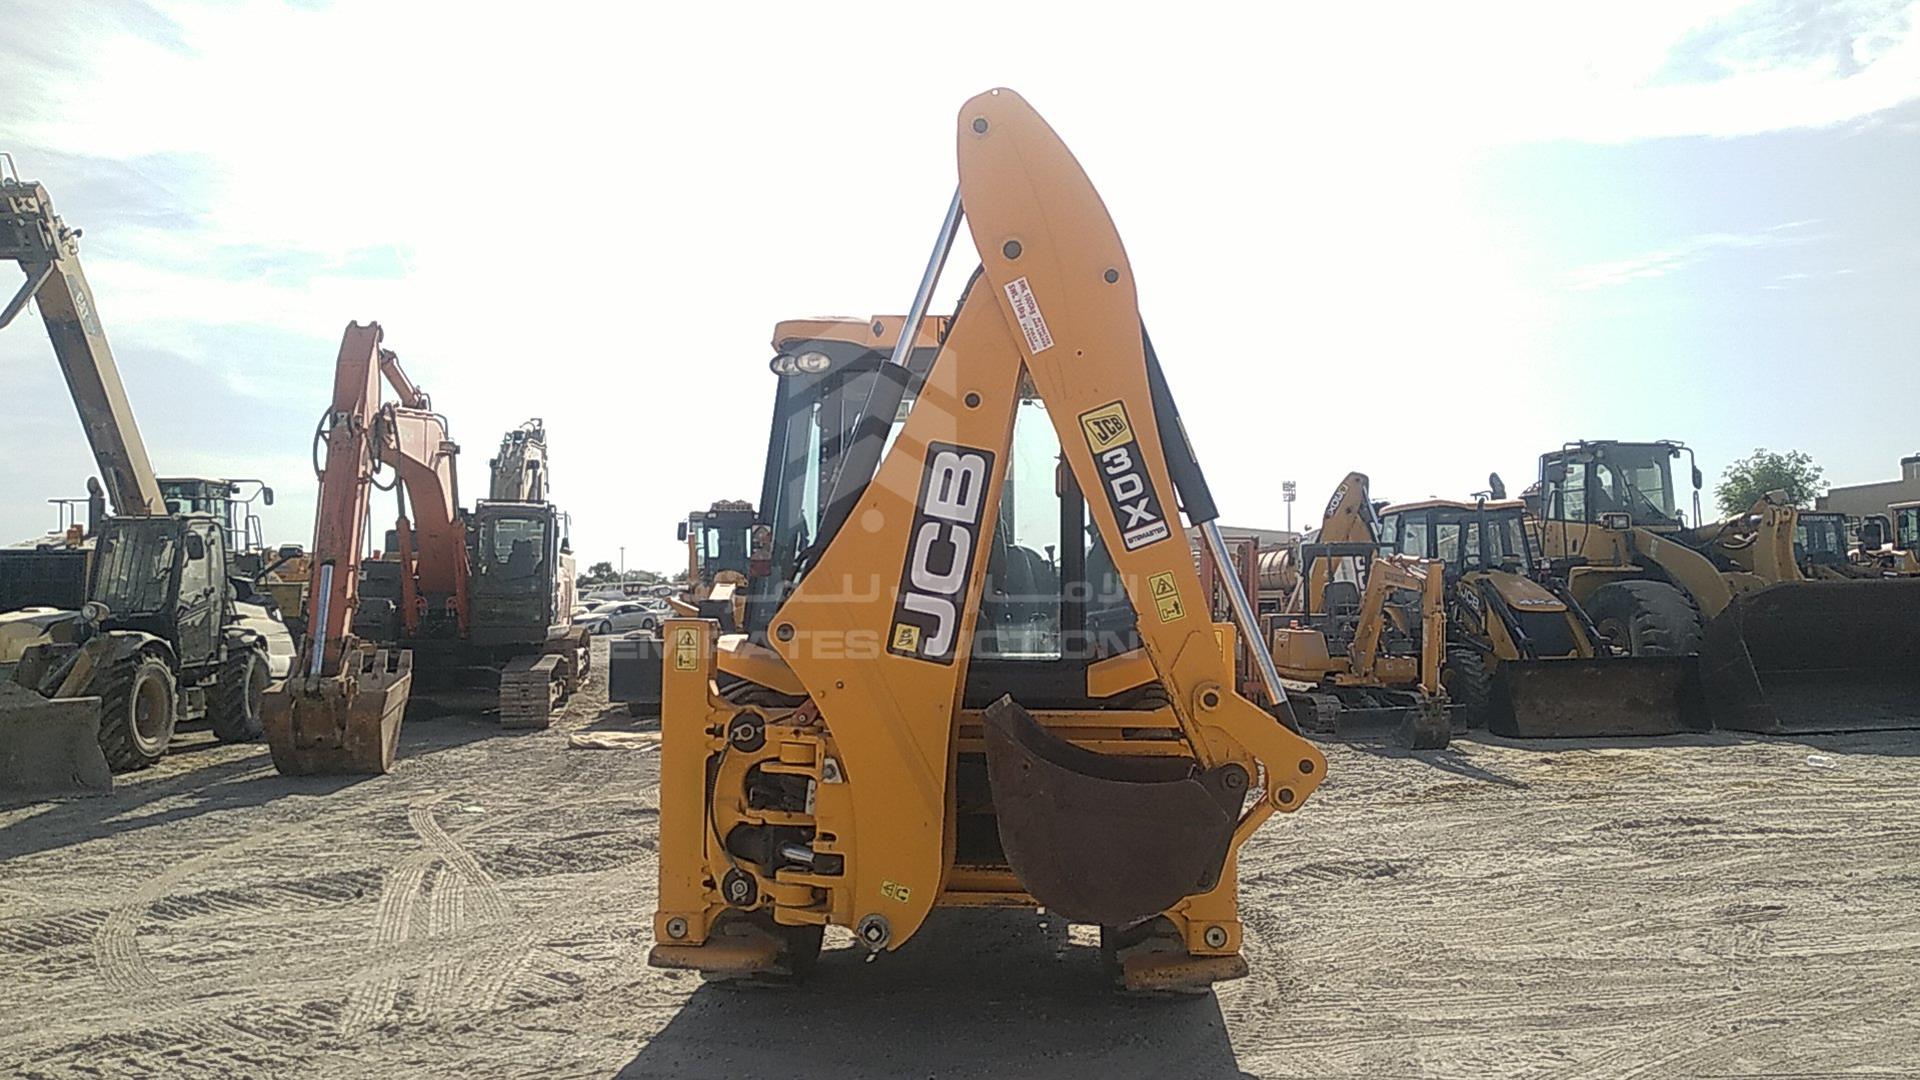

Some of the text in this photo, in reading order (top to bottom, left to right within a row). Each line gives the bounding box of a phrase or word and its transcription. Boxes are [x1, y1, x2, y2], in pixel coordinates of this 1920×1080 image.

[1093, 417, 1123, 442] JCB
[1102, 447, 1157, 529] 3DX
[1128, 526, 1165, 544] SITEMASTER
[904, 451, 985, 657] JCB
[1461, 588, 1479, 610] JCB
